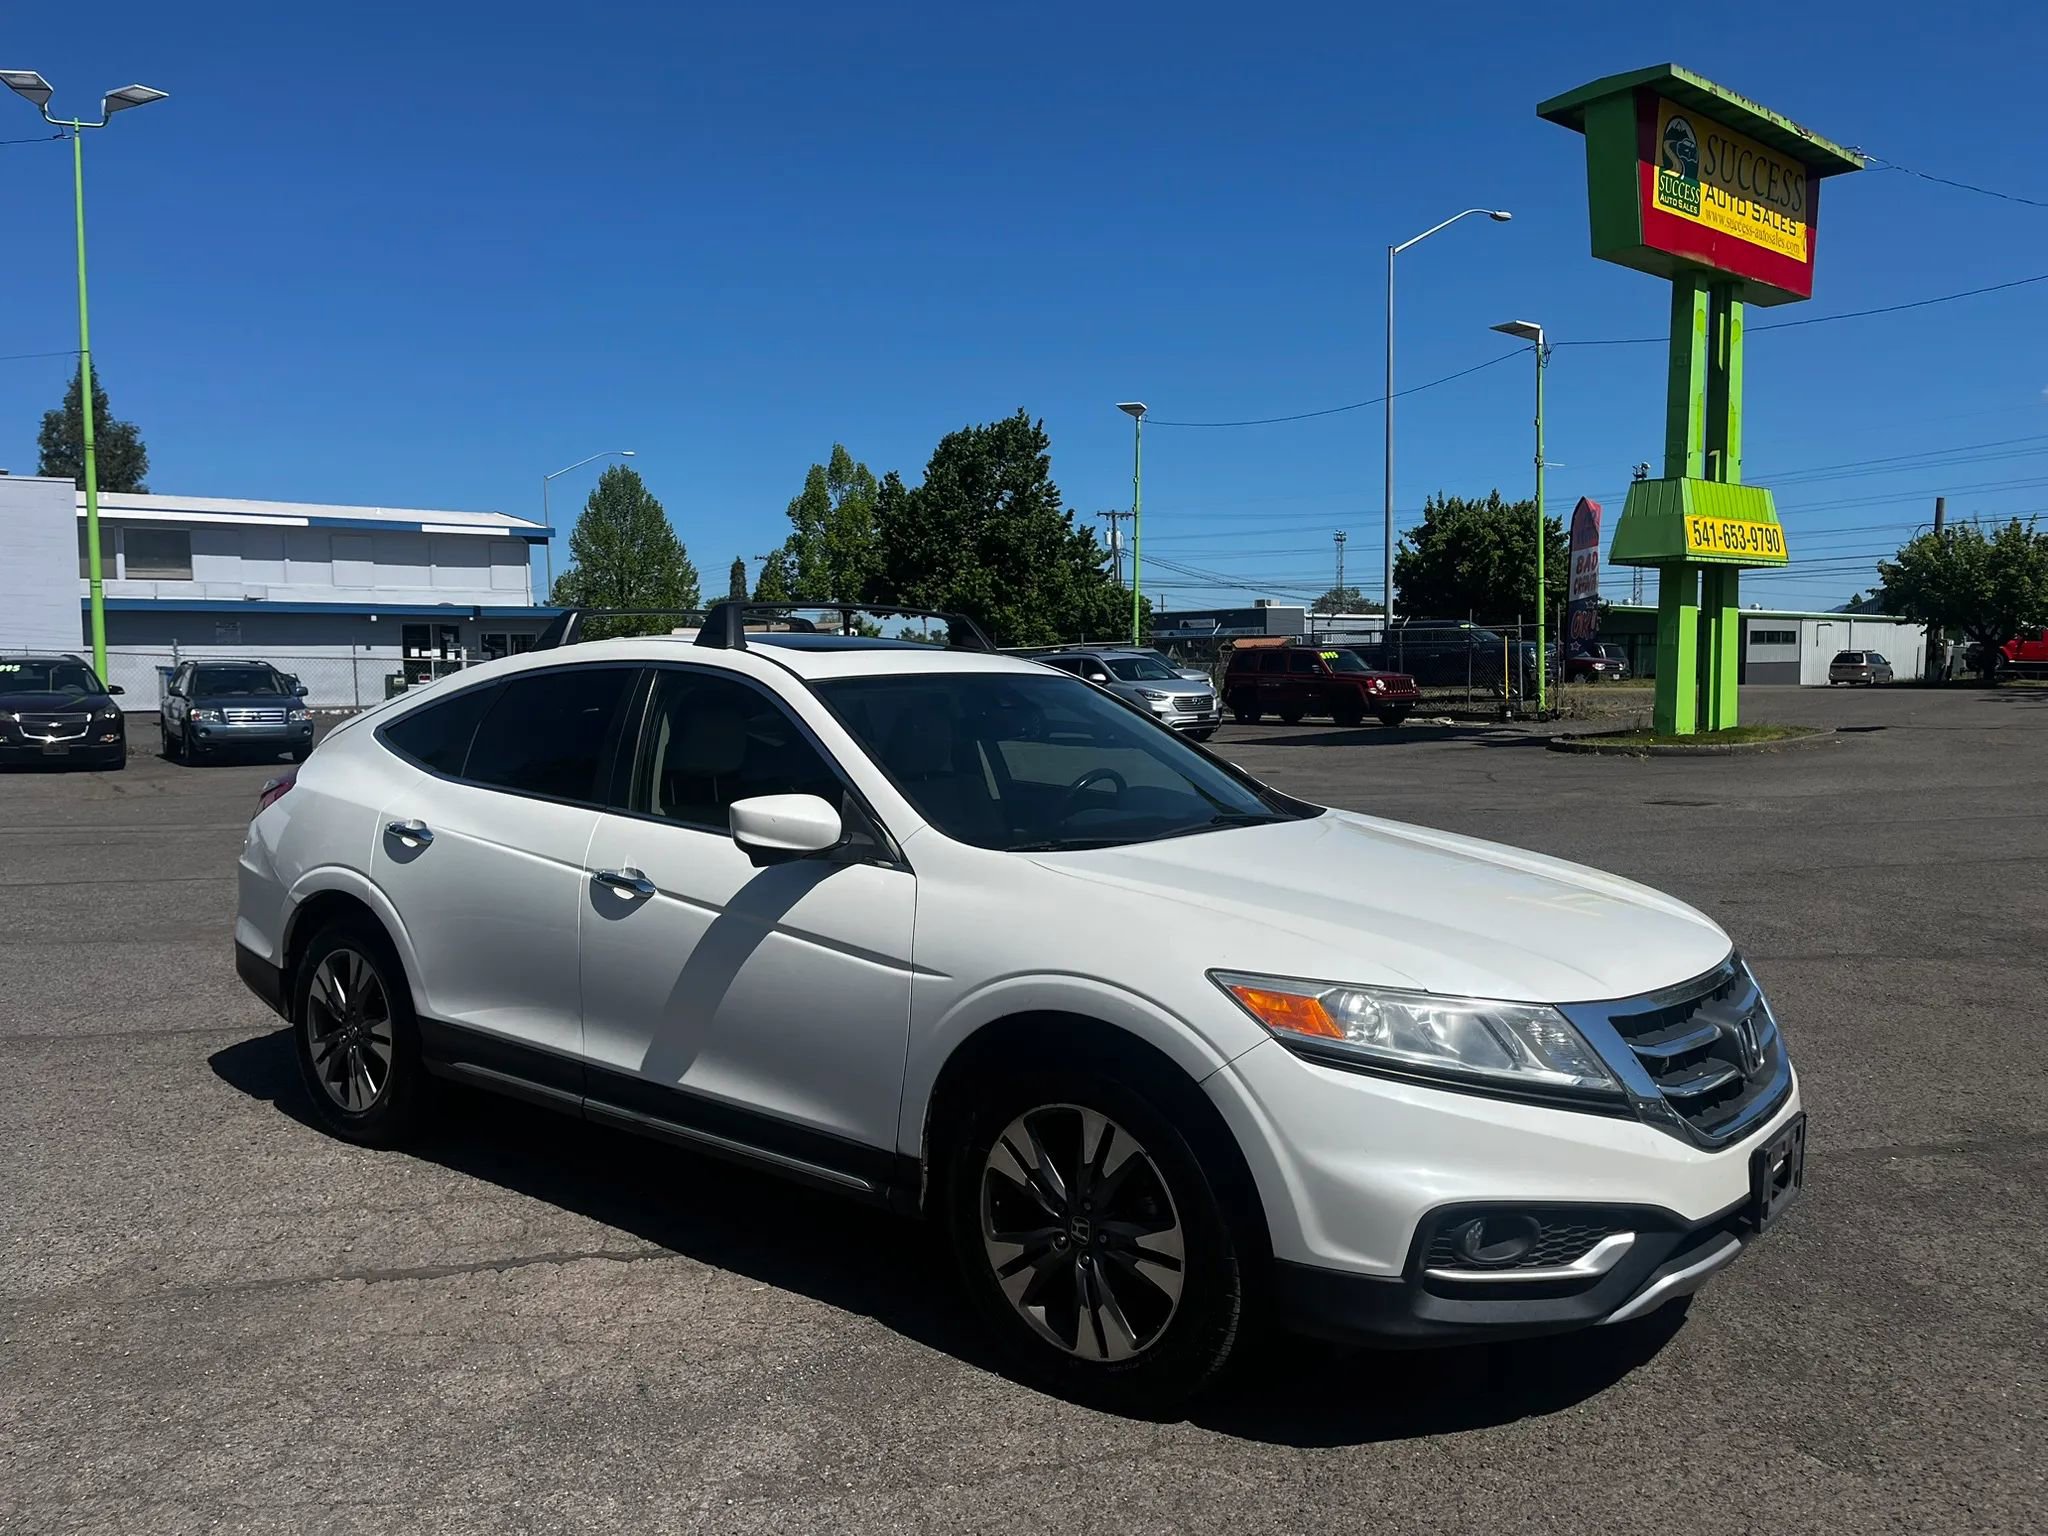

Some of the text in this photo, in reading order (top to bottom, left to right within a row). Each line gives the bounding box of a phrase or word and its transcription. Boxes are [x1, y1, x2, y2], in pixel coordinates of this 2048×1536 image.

[1704, 134, 1804, 212] SUCCESS
[1659, 175, 1701, 204] SUCCESS
[1660, 193, 1698, 214] AUTO SALES
[1705, 182, 1797, 236] AUTO SALES
[1693, 520, 1781, 553] 541-653-9790
[1576, 551, 1598, 575] BAD
